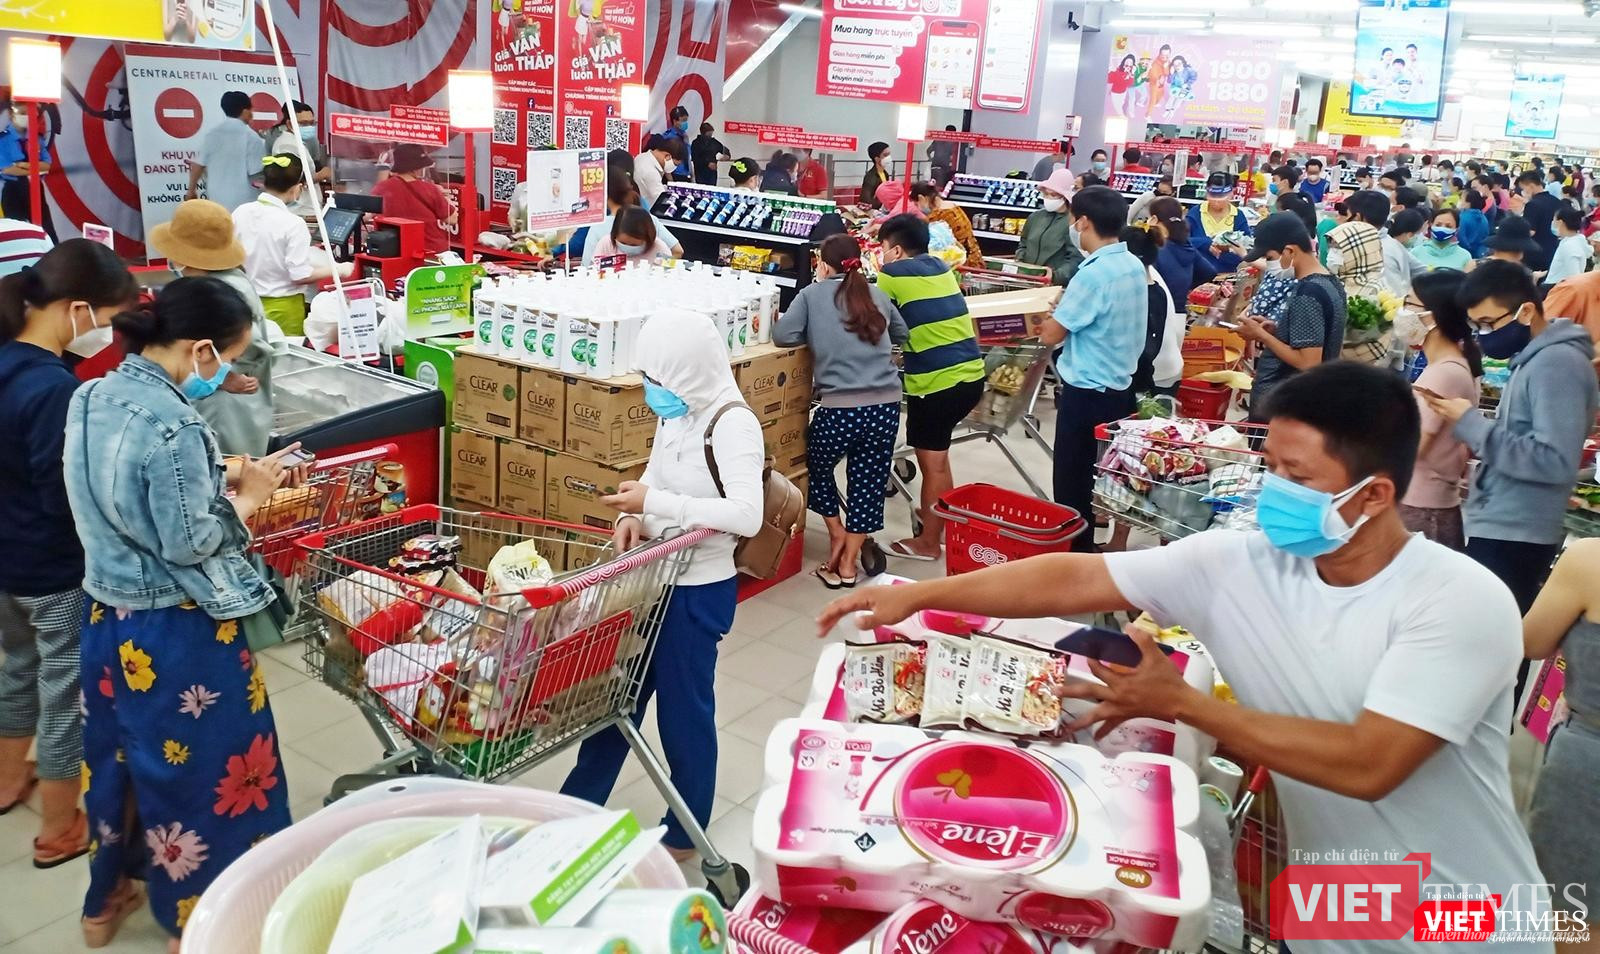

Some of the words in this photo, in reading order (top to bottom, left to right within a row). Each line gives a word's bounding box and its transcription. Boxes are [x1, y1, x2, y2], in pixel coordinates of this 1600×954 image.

[834, 24, 852, 34] Mua
[494, 62, 514, 72] luôn
[515, 49, 554, 71] THẤP
[594, 57, 636, 79] THẤP
[570, 69, 593, 80] luôn
[1208, 60, 1271, 80] 1900
[225, 74, 296, 87] CENTRALRETIL
[1208, 82, 1268, 102] 1880
[162, 151, 184, 160] KHU
[144, 165, 176, 174] ĐANG
[581, 167, 604, 184] 139
[147, 194, 181, 203] KHÔNG
[470, 375, 498, 394] CLEAR
[754, 376, 774, 390] CLEAR
[527, 390, 556, 409] CLEAR
[573, 402, 600, 421] CLEAR
[458, 449, 486, 468] CLEAR
[507, 461, 536, 480] CLEAR
[871, 679, 885, 696] Bò
[941, 824, 1056, 860] Elène
[1108, 855, 1130, 864] PACK
[1118, 870, 1146, 884] New
